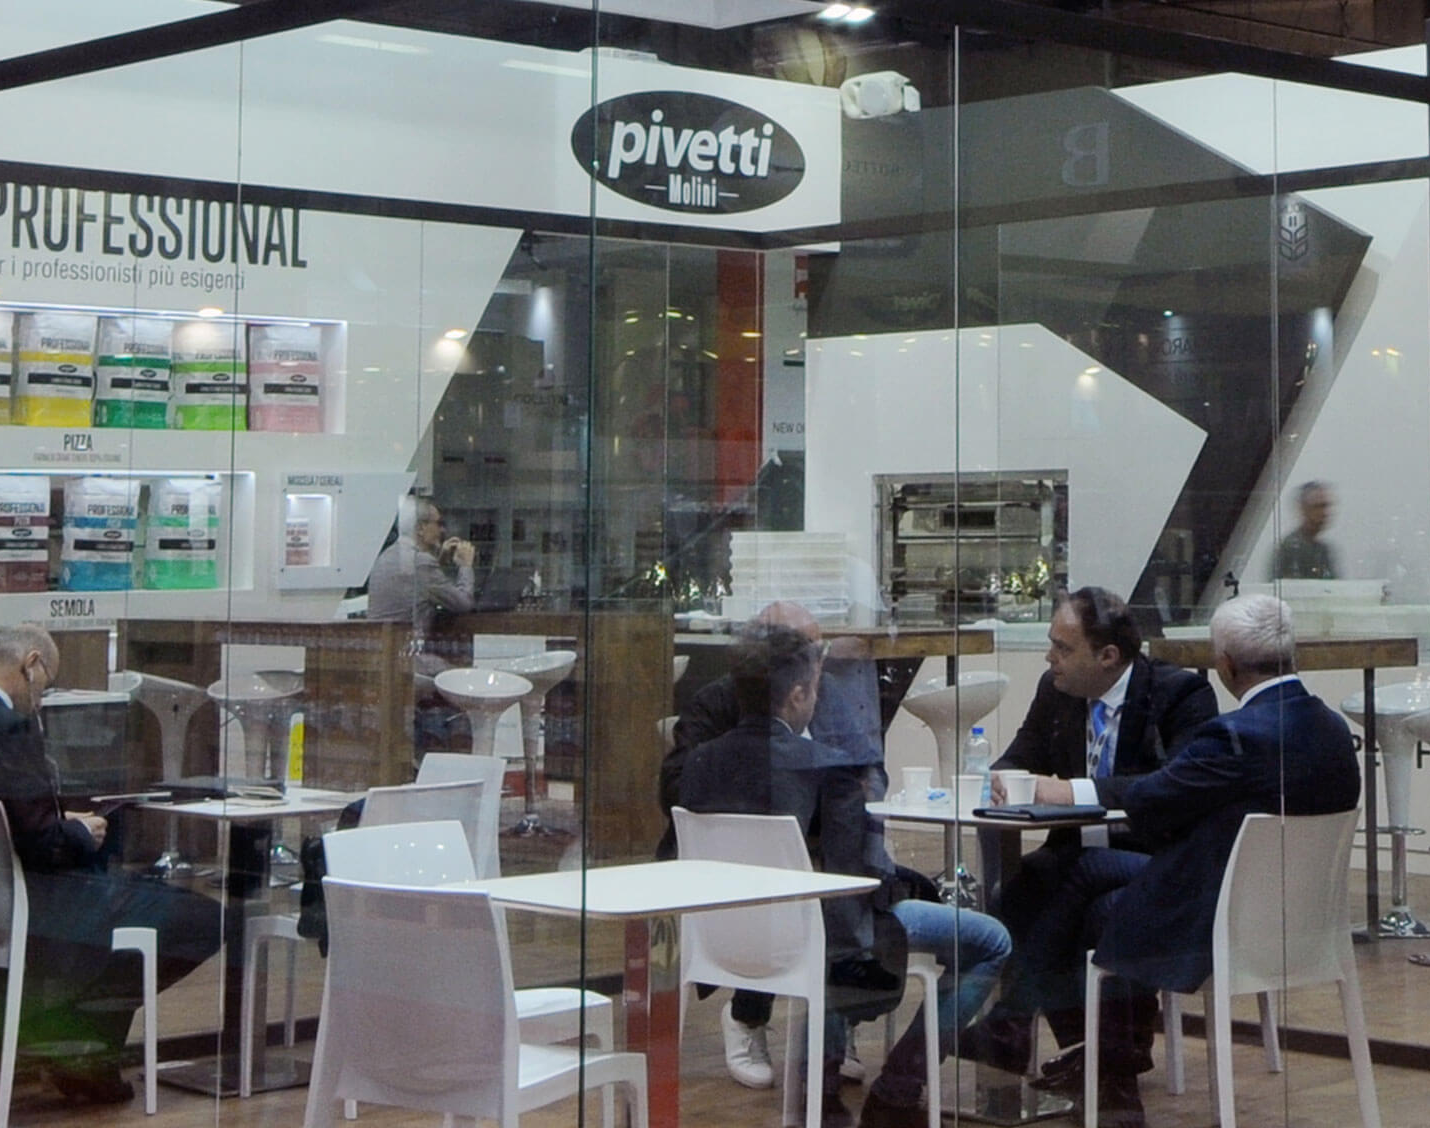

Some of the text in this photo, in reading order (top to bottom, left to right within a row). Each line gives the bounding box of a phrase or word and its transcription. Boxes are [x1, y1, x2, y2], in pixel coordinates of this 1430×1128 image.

[607, 109, 774, 180] pivetti
[668, 173, 718, 208] Molini
[11, 255, 17, 275] i
[22, 257, 142, 284] professionisti
[148, 265, 175, 287] più
[180, 268, 246, 293] esigenti
[64, 434, 93, 452] PIZZA
[50, 598, 95, 617] SEMOLA
